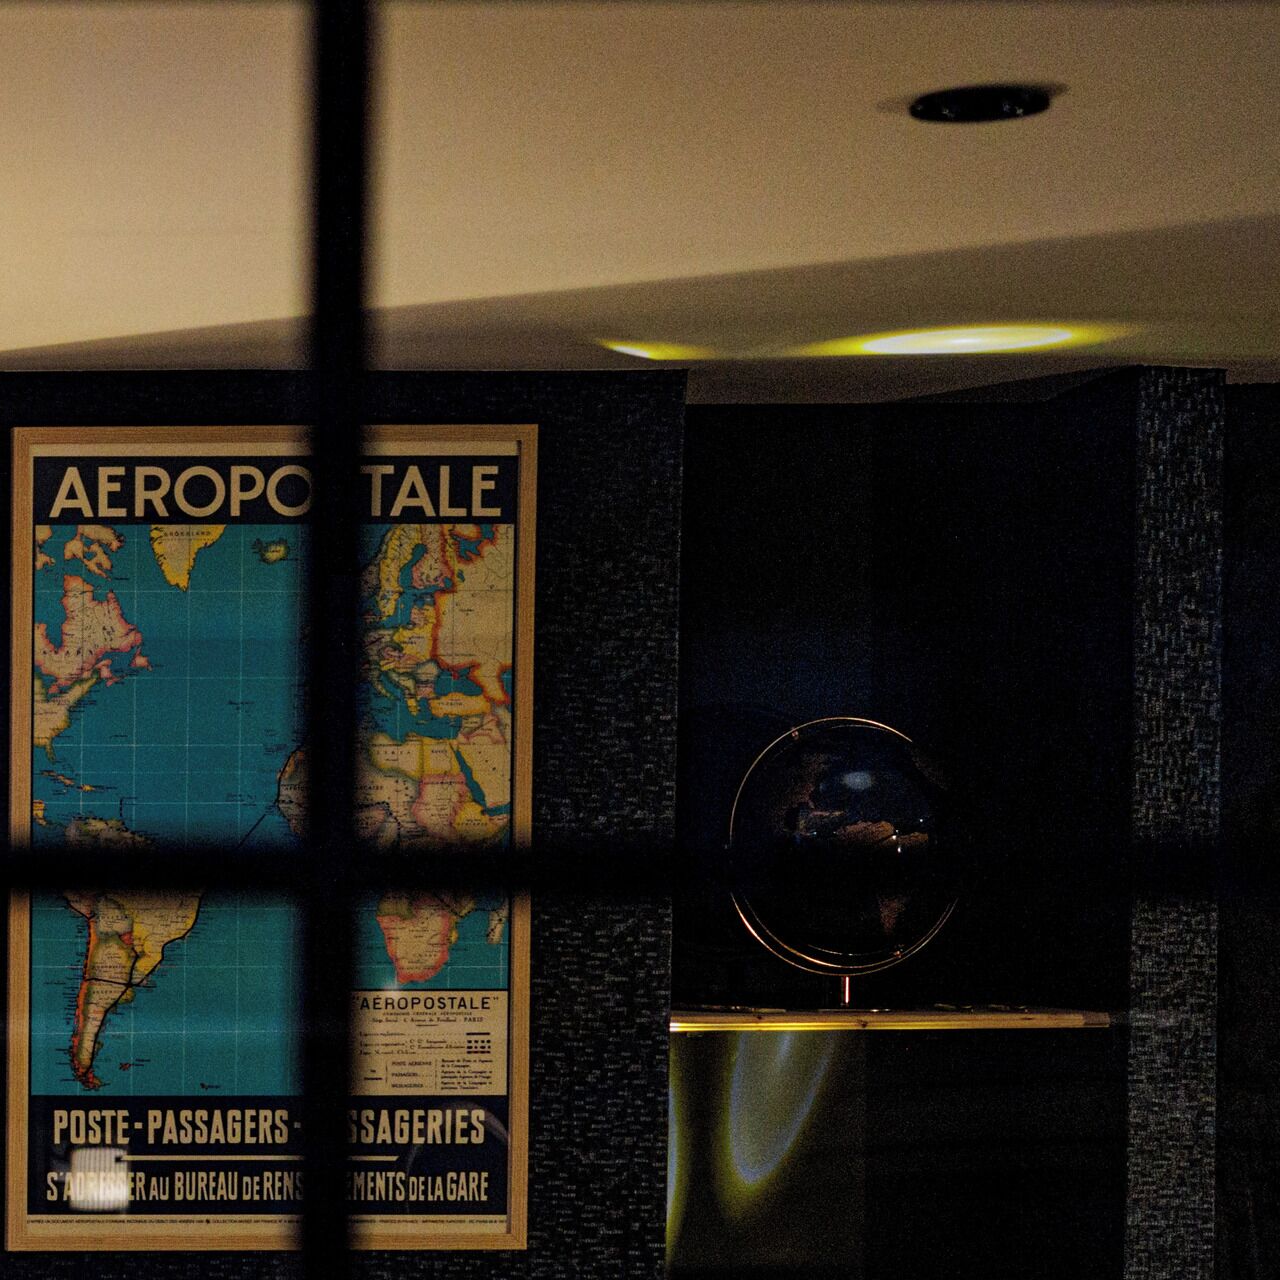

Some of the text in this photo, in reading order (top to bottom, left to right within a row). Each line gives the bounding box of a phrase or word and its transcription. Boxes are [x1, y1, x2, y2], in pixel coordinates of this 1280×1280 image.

[48, 465, 502, 519] AEROPOTALE
[53, 1109, 486, 1144] POSTE PASSAGERS SSAGERIES
[149, 1176, 170, 1201] AU
[173, 1171, 238, 1201] BUREAU
[241, 1176, 260, 1201] DE
[262, 1171, 406, 1202] RENSMENTS
[408, 1176, 425, 1201] DE
[427, 1176, 441, 1201] LA
[446, 1171, 489, 1202] GARE
